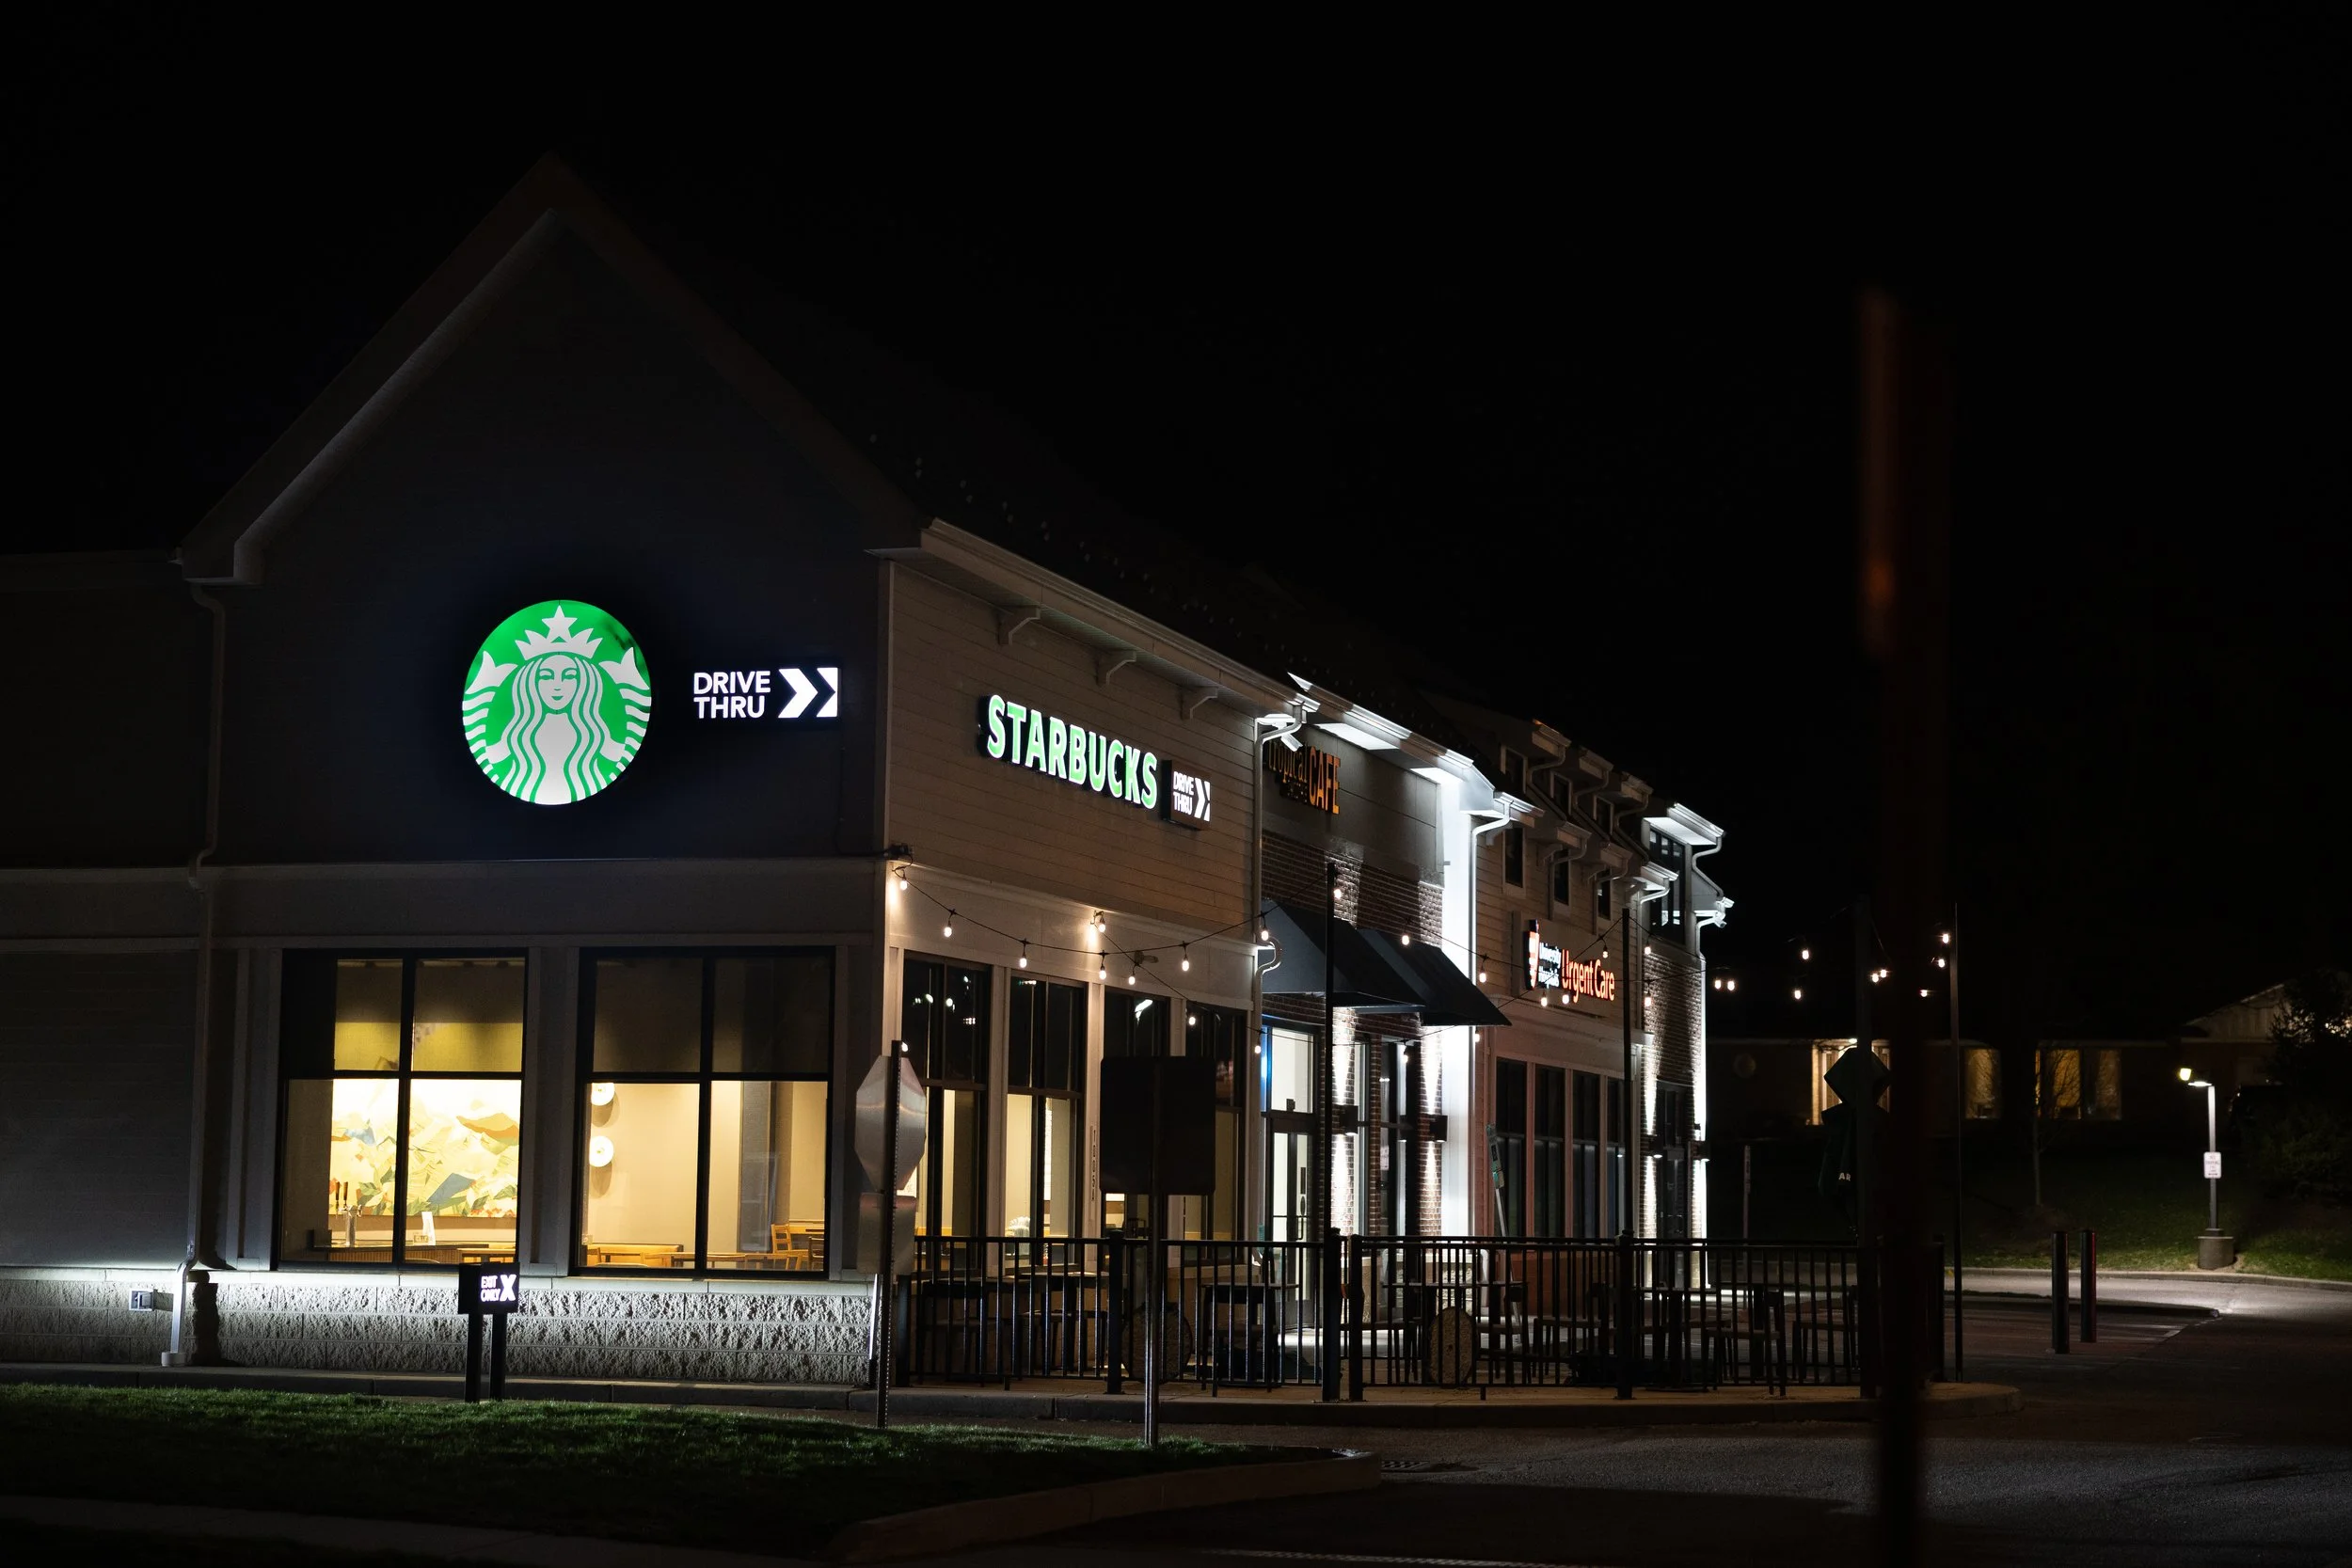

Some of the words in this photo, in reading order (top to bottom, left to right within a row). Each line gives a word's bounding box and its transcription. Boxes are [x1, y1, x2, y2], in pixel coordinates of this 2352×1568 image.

[693, 671, 771, 694] DRIVE
[693, 695, 765, 719] THRU
[987, 694, 1158, 809] STARBUCKS
[1173, 770, 1194, 796] DRIVE
[1309, 746, 1341, 815] CAFE
[1173, 791, 1193, 816] THRU
[1562, 949, 1595, 1004] Urgent
[1595, 958, 1615, 1001] Care
[481, 1275, 498, 1289] EXIT
[481, 1289, 501, 1302] ONLY
